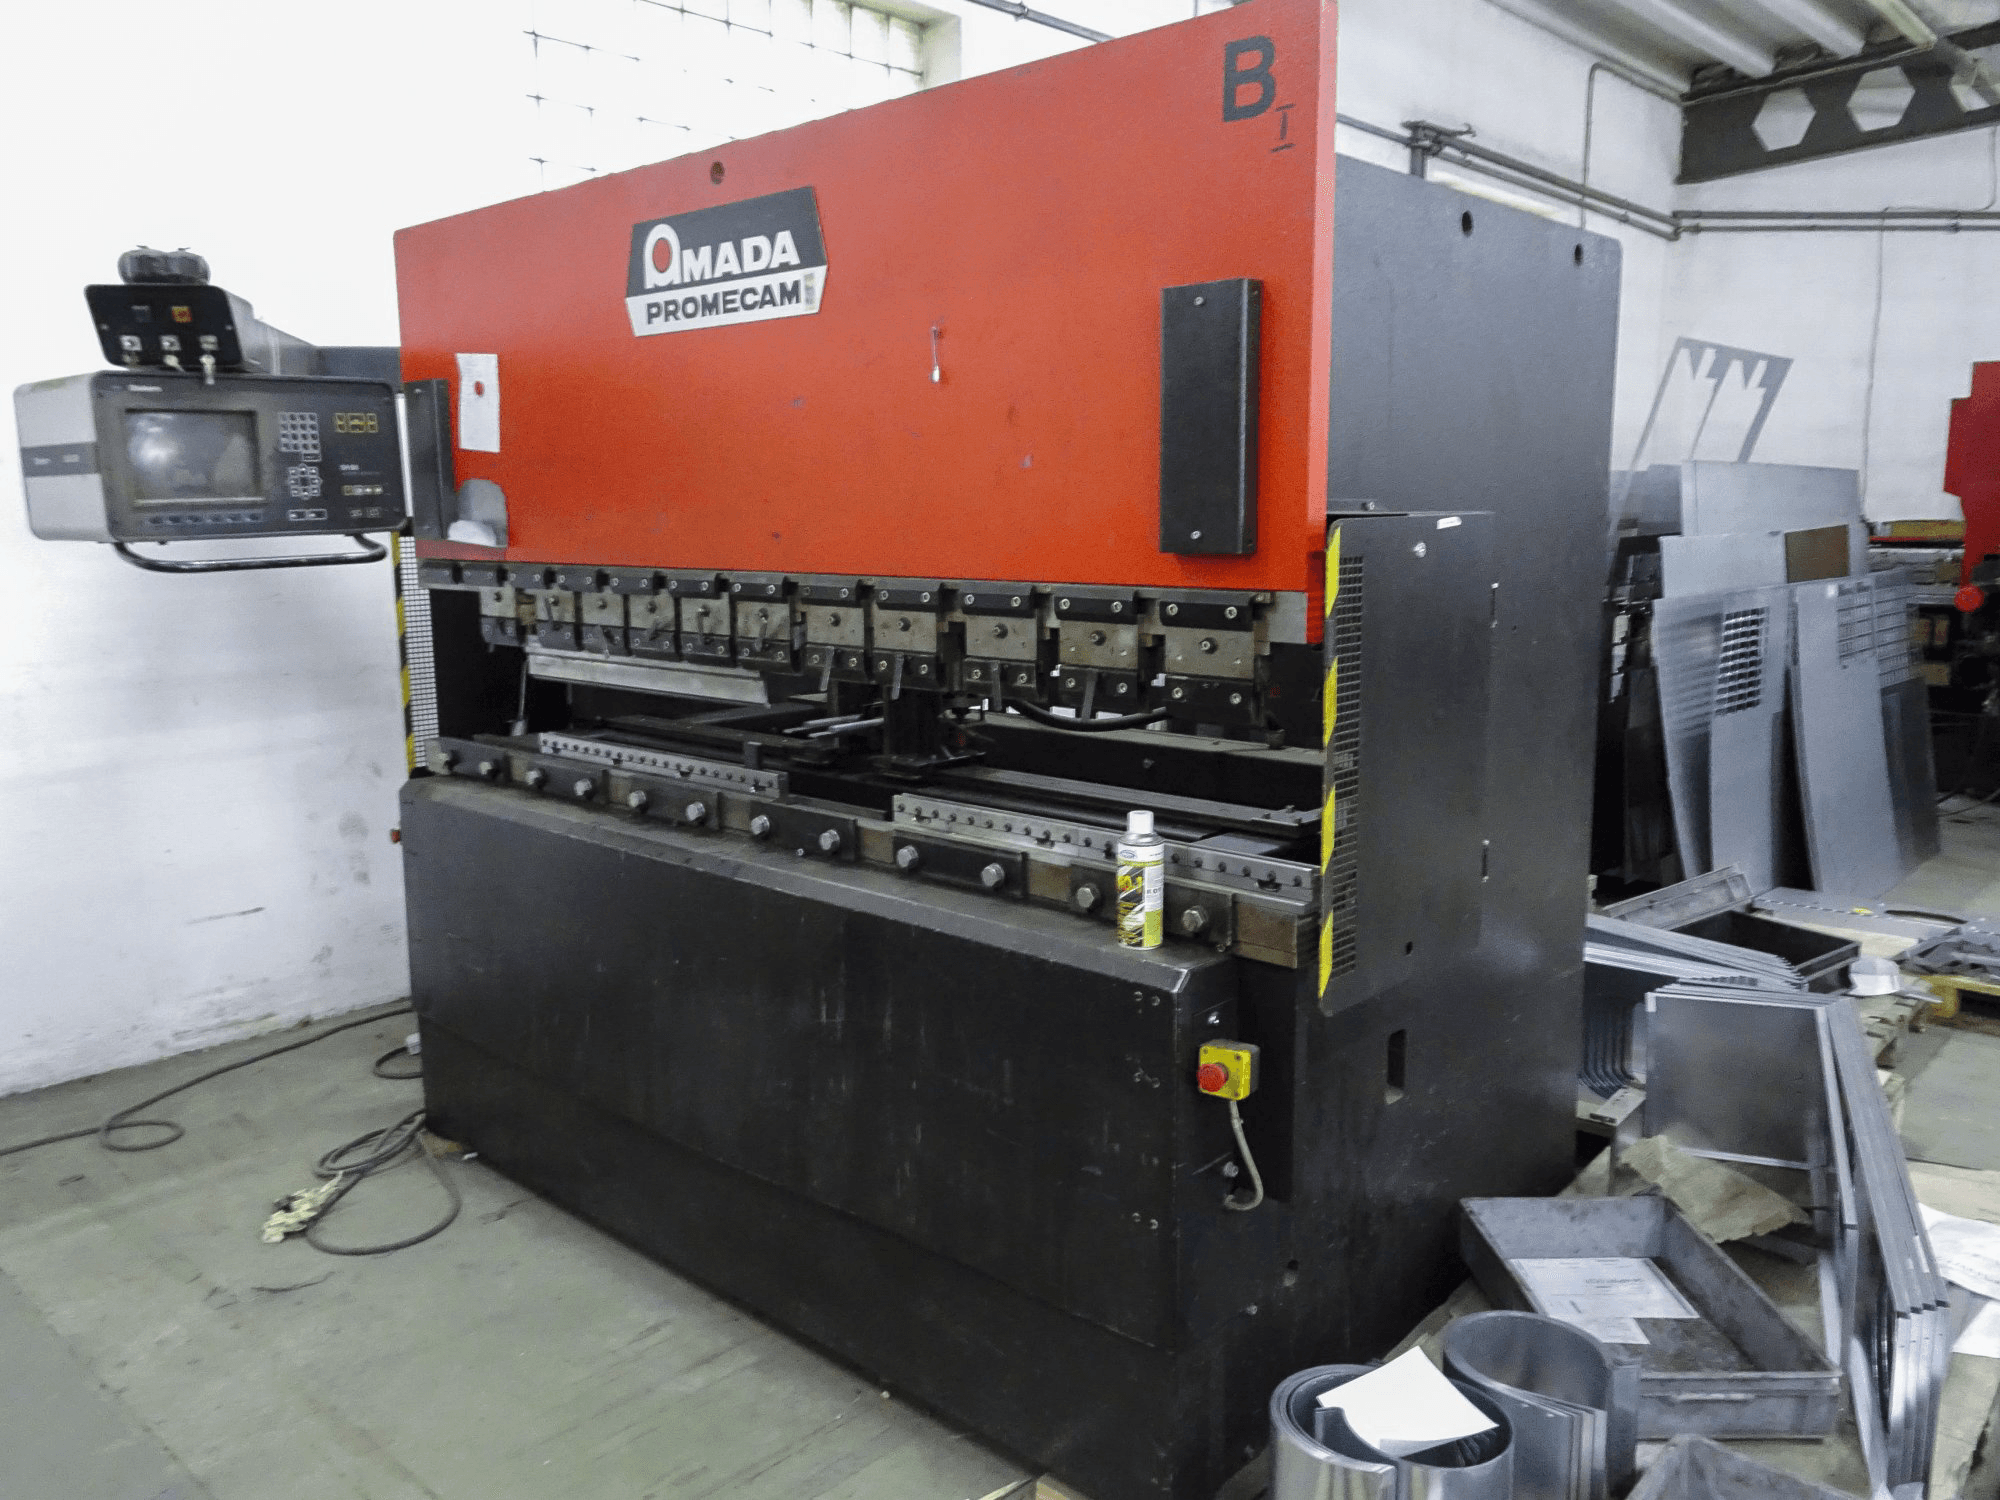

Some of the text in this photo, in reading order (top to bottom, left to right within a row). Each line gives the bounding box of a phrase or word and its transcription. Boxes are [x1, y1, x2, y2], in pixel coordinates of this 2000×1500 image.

[1223, 35, 1276, 122] B
[643, 223, 801, 290] AMADA
[646, 279, 801, 325] PROMECAM
